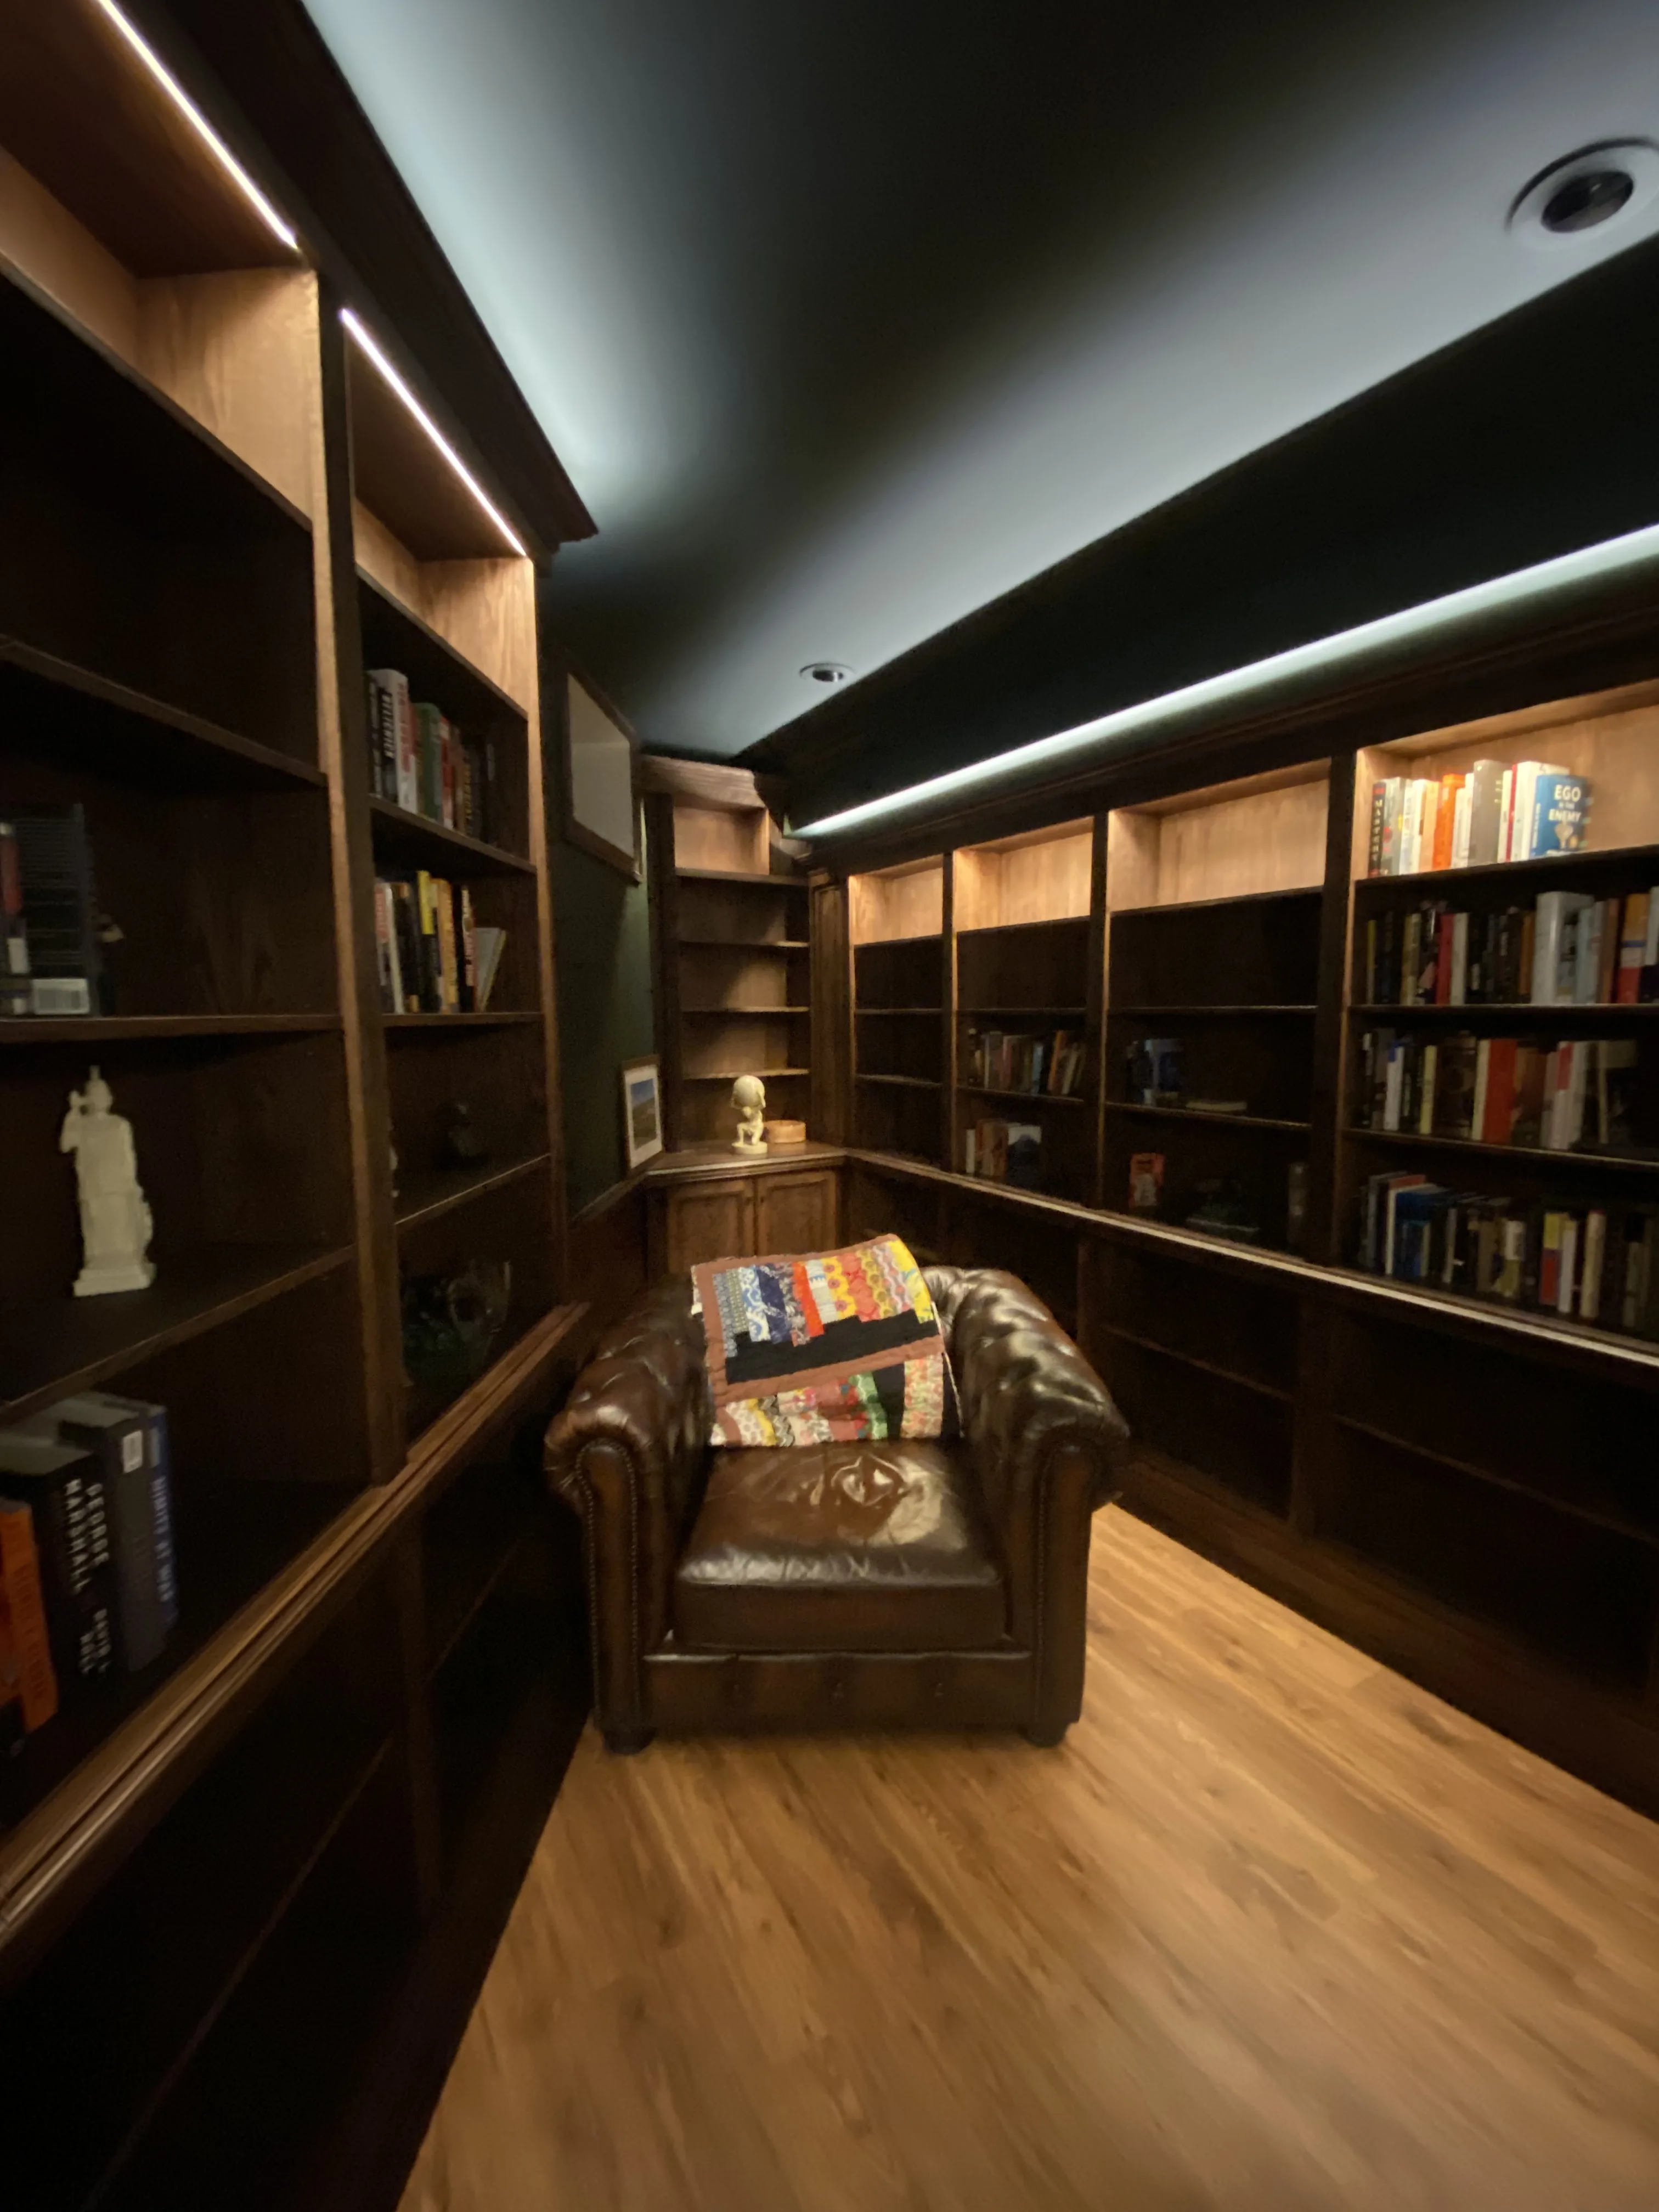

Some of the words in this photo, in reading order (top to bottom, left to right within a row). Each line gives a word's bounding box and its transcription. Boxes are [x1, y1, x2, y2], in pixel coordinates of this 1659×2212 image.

[1549, 809, 1582, 822] ENEMY
[1554, 784, 1581, 802] EGO
[64, 1478, 92, 1594] MARSHALL
[86, 1482, 109, 1566] GEORGE
